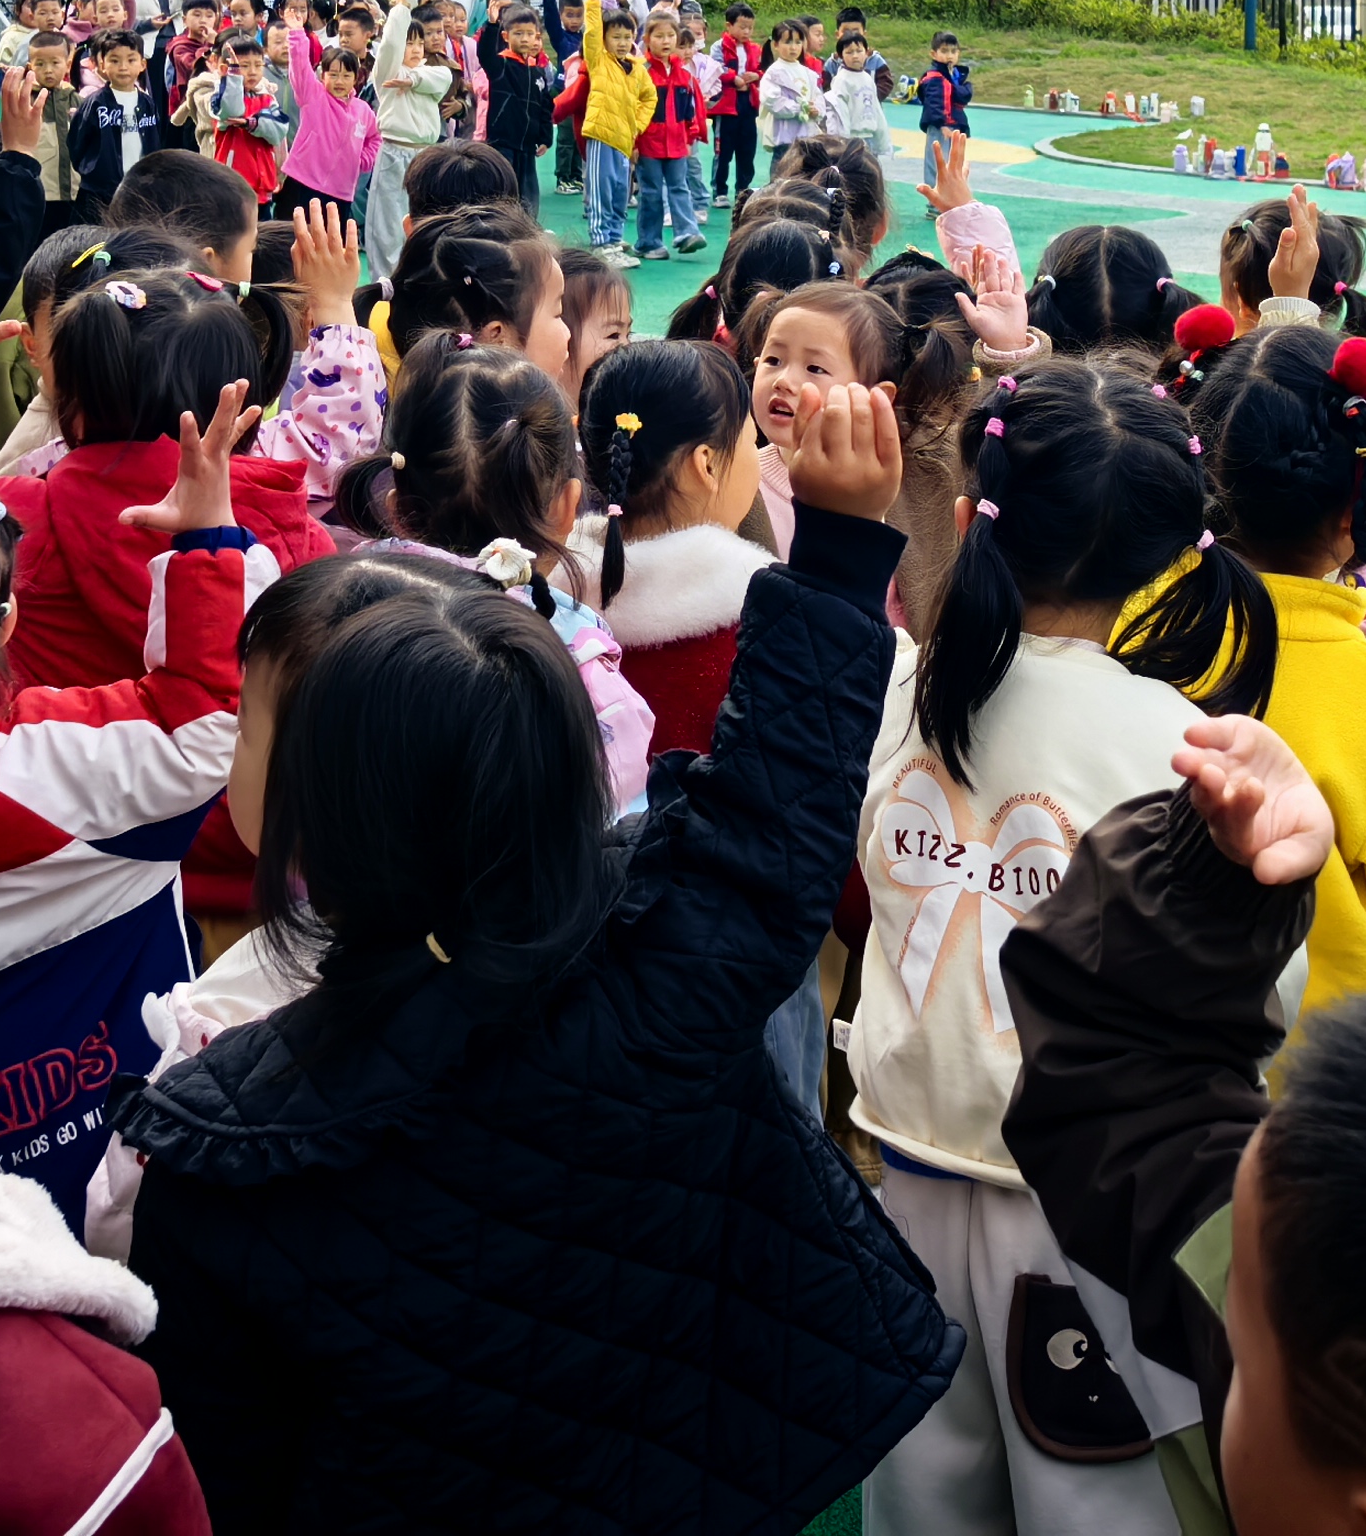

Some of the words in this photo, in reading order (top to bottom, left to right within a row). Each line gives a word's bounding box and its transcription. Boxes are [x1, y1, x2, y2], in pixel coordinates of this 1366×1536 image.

[892, 758, 937, 789] BEAUTIFUL
[990, 792, 1026, 826] Romance
[1029, 791, 1041, 802] of
[11, 1134, 50, 1166] KIDS
[56, 1121, 78, 1145] GO
[82, 1103, 105, 1131] WI
